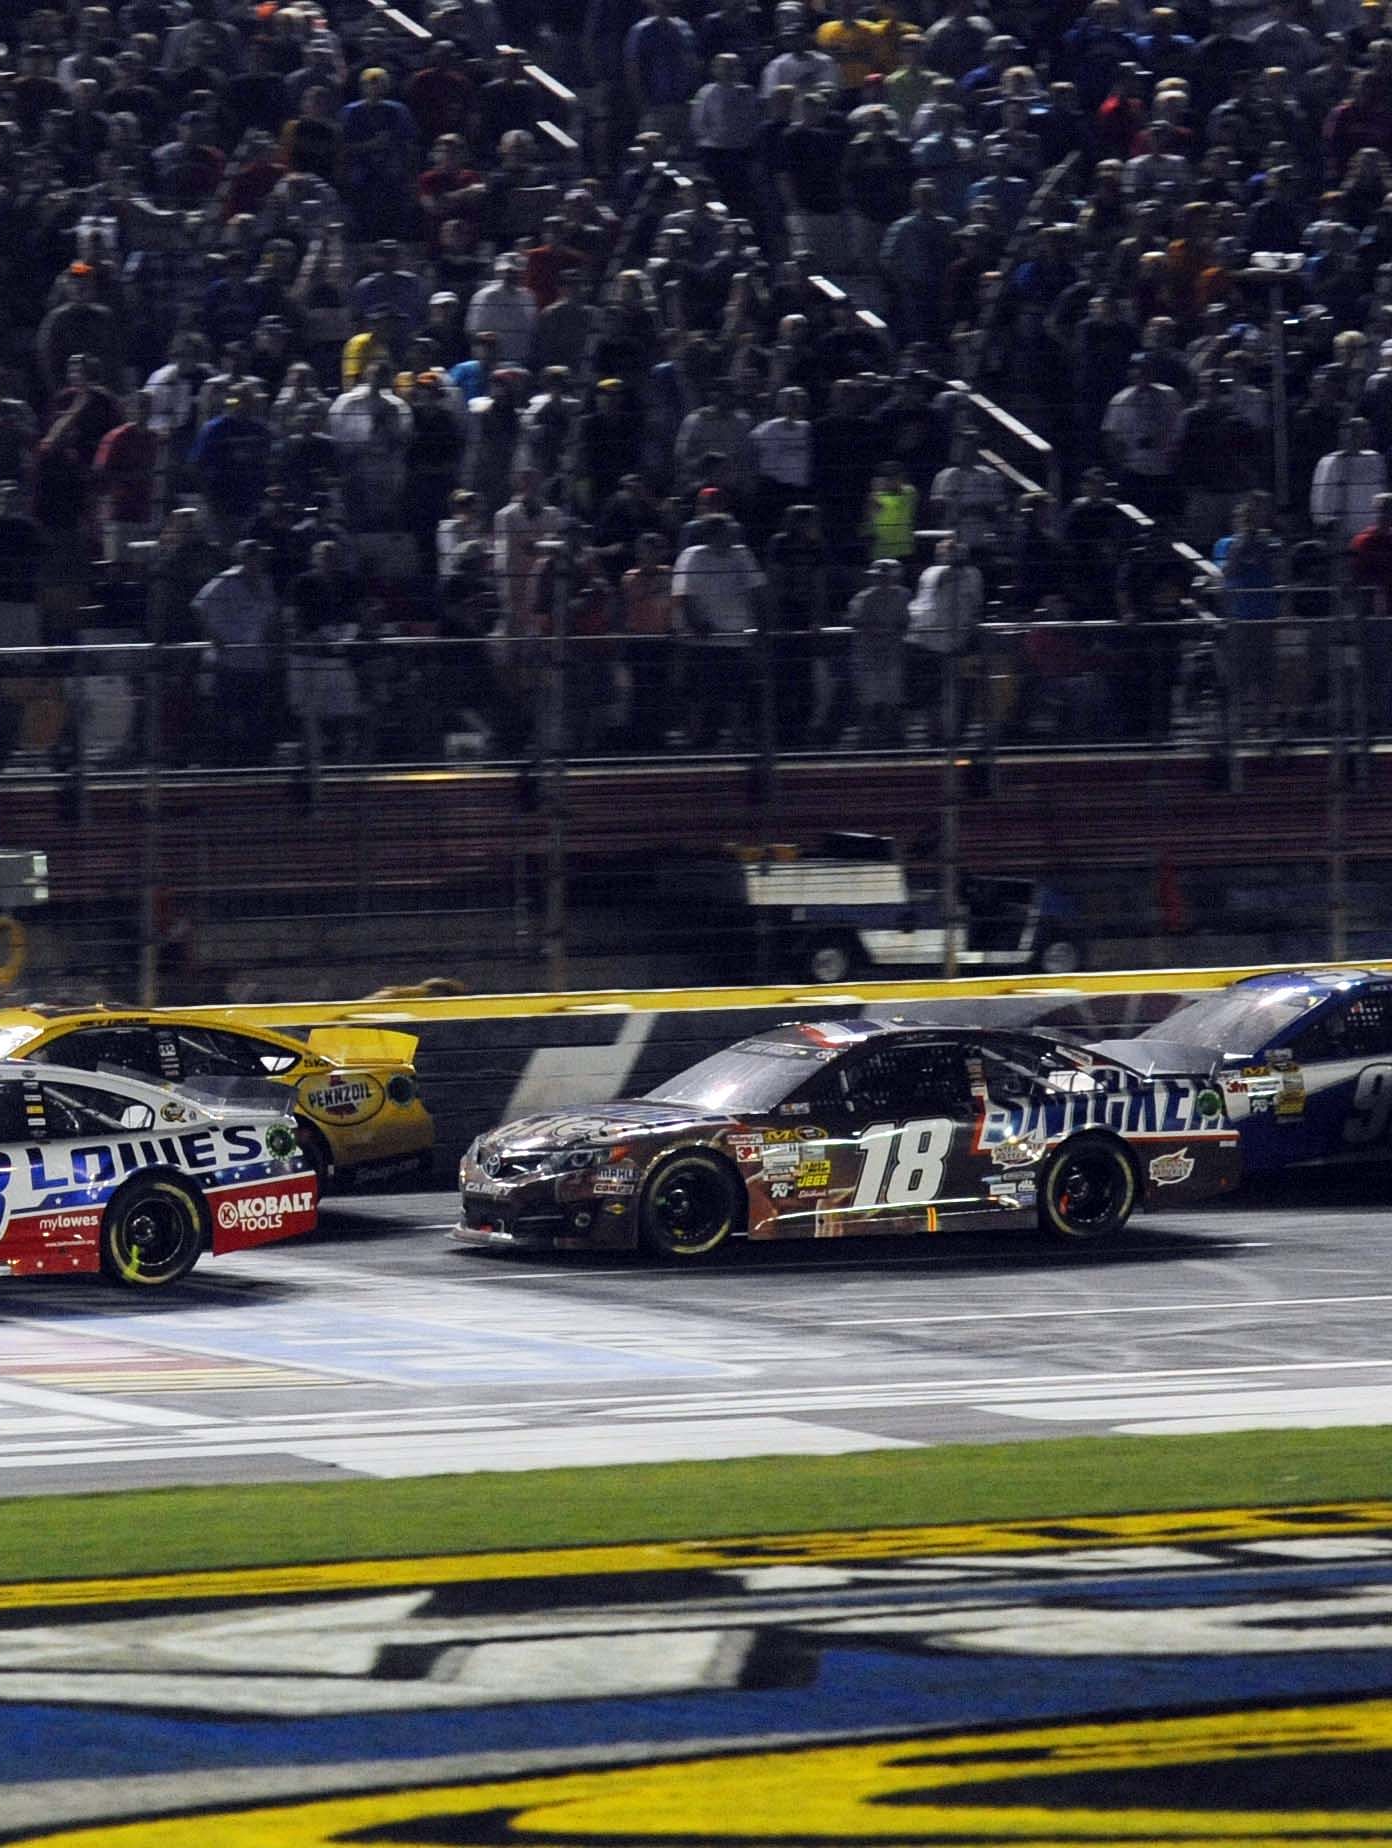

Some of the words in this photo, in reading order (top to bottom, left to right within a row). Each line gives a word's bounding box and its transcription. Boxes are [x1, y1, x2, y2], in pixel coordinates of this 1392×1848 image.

[307, 1082, 374, 1108] PENNZOIL
[26, 1125, 263, 1191] LOWE'S
[852, 1118, 954, 1208] 18
[798, 1176, 830, 1187] JEGS
[237, 1192, 313, 1218] KOBALT
[39, 1214, 98, 1235] mylowes
[240, 1213, 283, 1232] TOOLS
